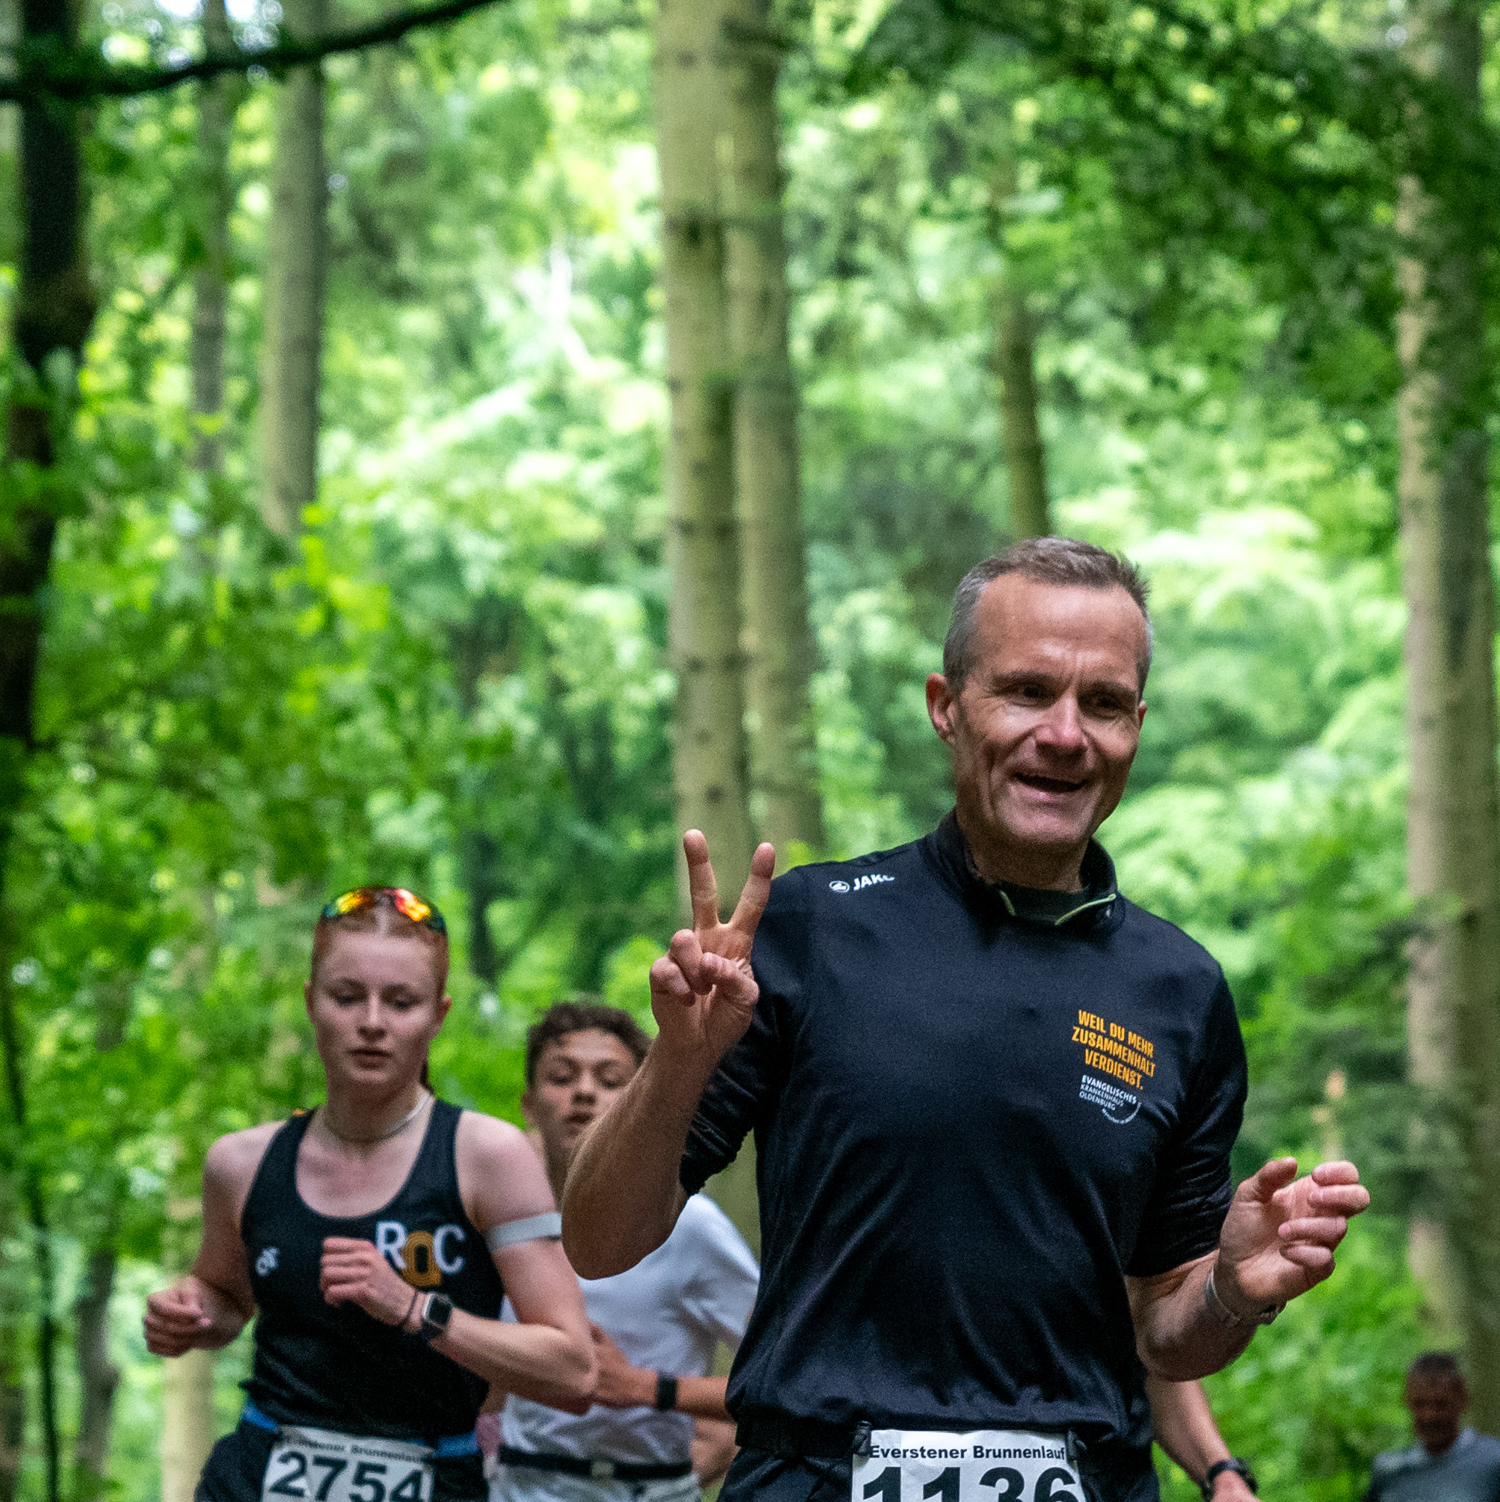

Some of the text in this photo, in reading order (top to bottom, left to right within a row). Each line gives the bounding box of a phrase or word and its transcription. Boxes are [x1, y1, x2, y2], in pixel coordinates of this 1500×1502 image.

[1078, 1009, 1154, 1058] WEIL DU MEHR
[1071, 1026, 1156, 1077] ZUSAMMENHALT
[1084, 1048, 1144, 1090] VERDIENST.
[1079, 1091, 1116, 1111] OLDENBURG
[1080, 1083, 1124, 1107] KRANKENHAUS
[1081, 1074, 1137, 1105] EVANGELISCHES
[350, 1446, 430, 1463] Brunnenlau
[870, 1445, 1066, 1461] Everstener Brunnenlauf
